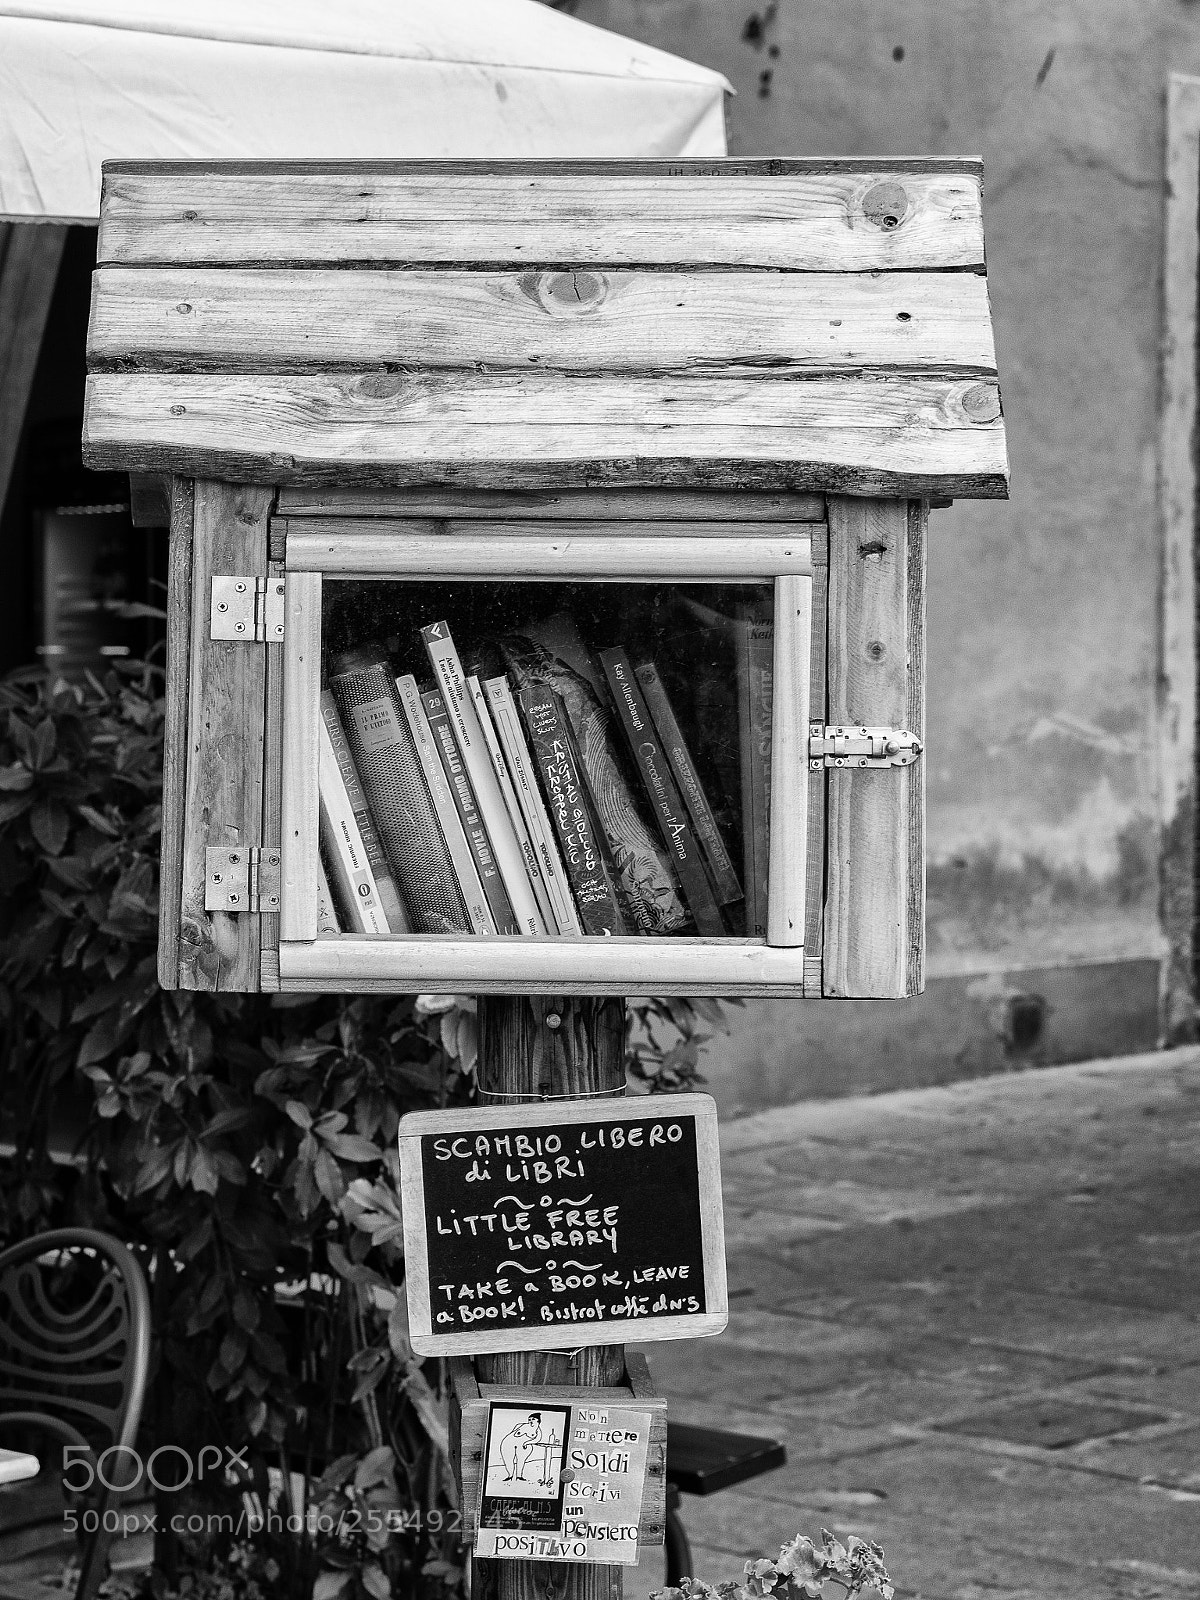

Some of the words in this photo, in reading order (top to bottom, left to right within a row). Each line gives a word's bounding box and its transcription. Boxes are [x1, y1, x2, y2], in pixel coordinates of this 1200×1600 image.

[451, 673, 465, 701] Phillips
[613, 663, 625, 680] Kay
[620, 682, 645, 732] Allenbaugh
[428, 697, 441, 709] 29
[437, 723, 462, 774] OTTOBRE
[323, 708, 344, 748] CHRIS
[337, 750, 360, 797] CLEAVE
[351, 799, 374, 842] LITTLE
[454, 774, 475, 812] PRIMO
[550, 739, 578, 804] KRISTIAN
[572, 808, 597, 871] GIDLUND
[638, 742, 668, 801] Cioccolatini
[660, 802, 672, 818] per
[666, 816, 687, 860] l'Anima
[466, 813, 479, 825] IL
[545, 764, 570, 830] KROPPEN
[564, 833, 580, 864] MIN
[472, 829, 492, 866] HOYLE
[484, 866, 496, 878] F.
[433, 1134, 562, 1161] SCAMBIO
[580, 1124, 683, 1149] LIBERO
[465, 1160, 492, 1183] di
[546, 1205, 620, 1230] FREE
[507, 1227, 618, 1254] LIBRARY
[438, 1278, 513, 1301] TAKE
[524, 1280, 540, 1293] a
[548, 1270, 630, 1292] BOOK,
[633, 1265, 690, 1284] LEAVE
[437, 1311, 455, 1324] a
[458, 1296, 526, 1323] BOOK!
[540, 1299, 607, 1322] Bistrot
[578, 1410, 608, 1424] Non
[571, 1449, 629, 1474] Soldi
[565, 1506, 584, 1516] un
